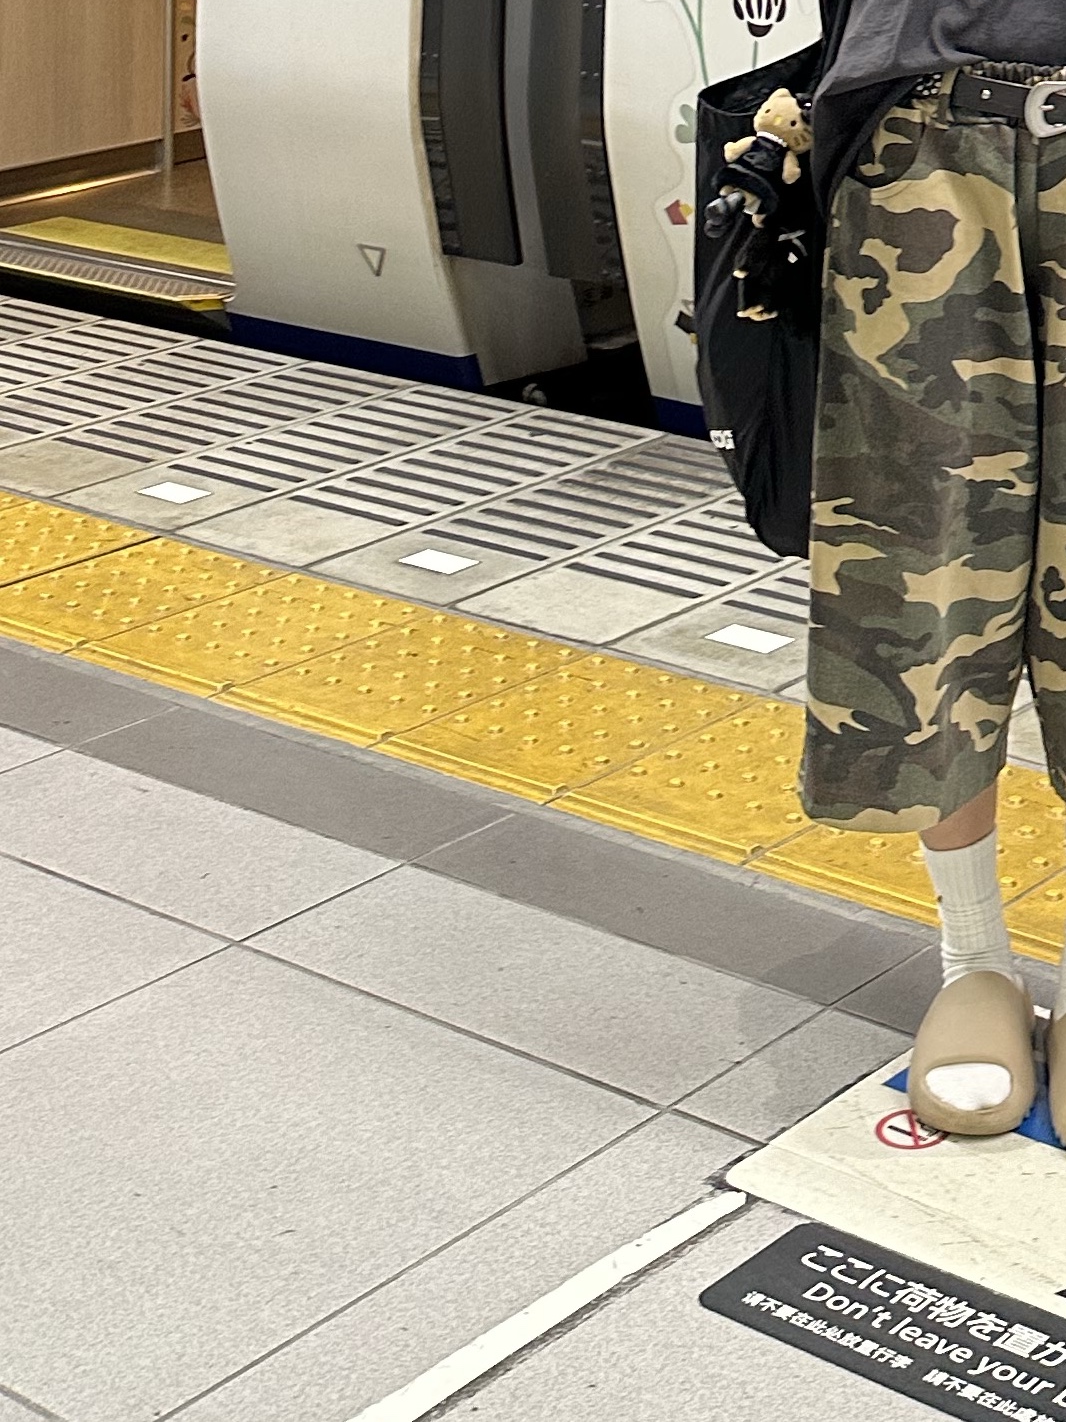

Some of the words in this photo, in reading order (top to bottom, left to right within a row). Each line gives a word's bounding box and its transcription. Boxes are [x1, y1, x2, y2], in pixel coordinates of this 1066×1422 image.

[801, 1281, 893, 1329] Don't
[888, 1316, 974, 1363] leave
[966, 1355, 1056, 1395] your
